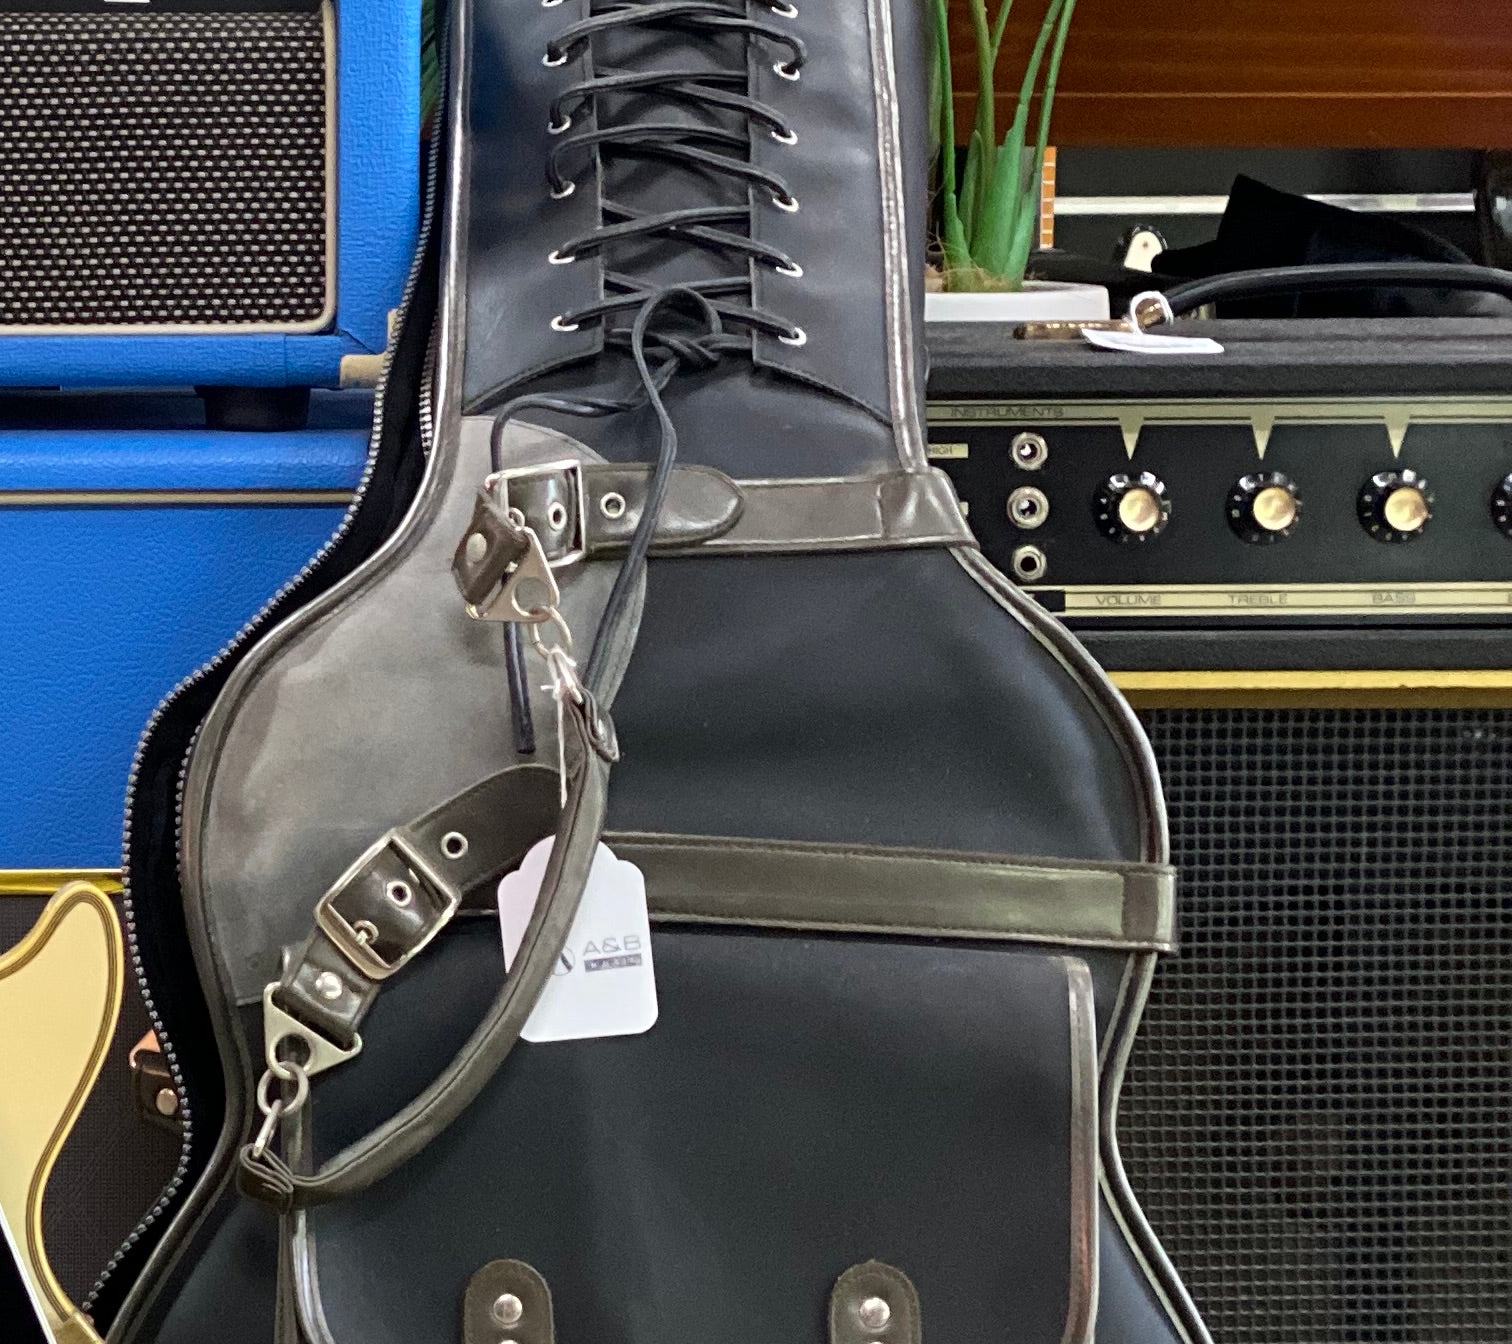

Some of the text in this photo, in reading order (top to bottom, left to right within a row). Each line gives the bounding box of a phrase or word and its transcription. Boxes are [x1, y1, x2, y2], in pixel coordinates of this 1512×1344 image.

[950, 406, 1064, 418] INSTRUMENTS
[1095, 594, 1161, 606] VOLUME
[1227, 593, 1288, 605] TREBLE
[583, 935, 642, 956] A&B
